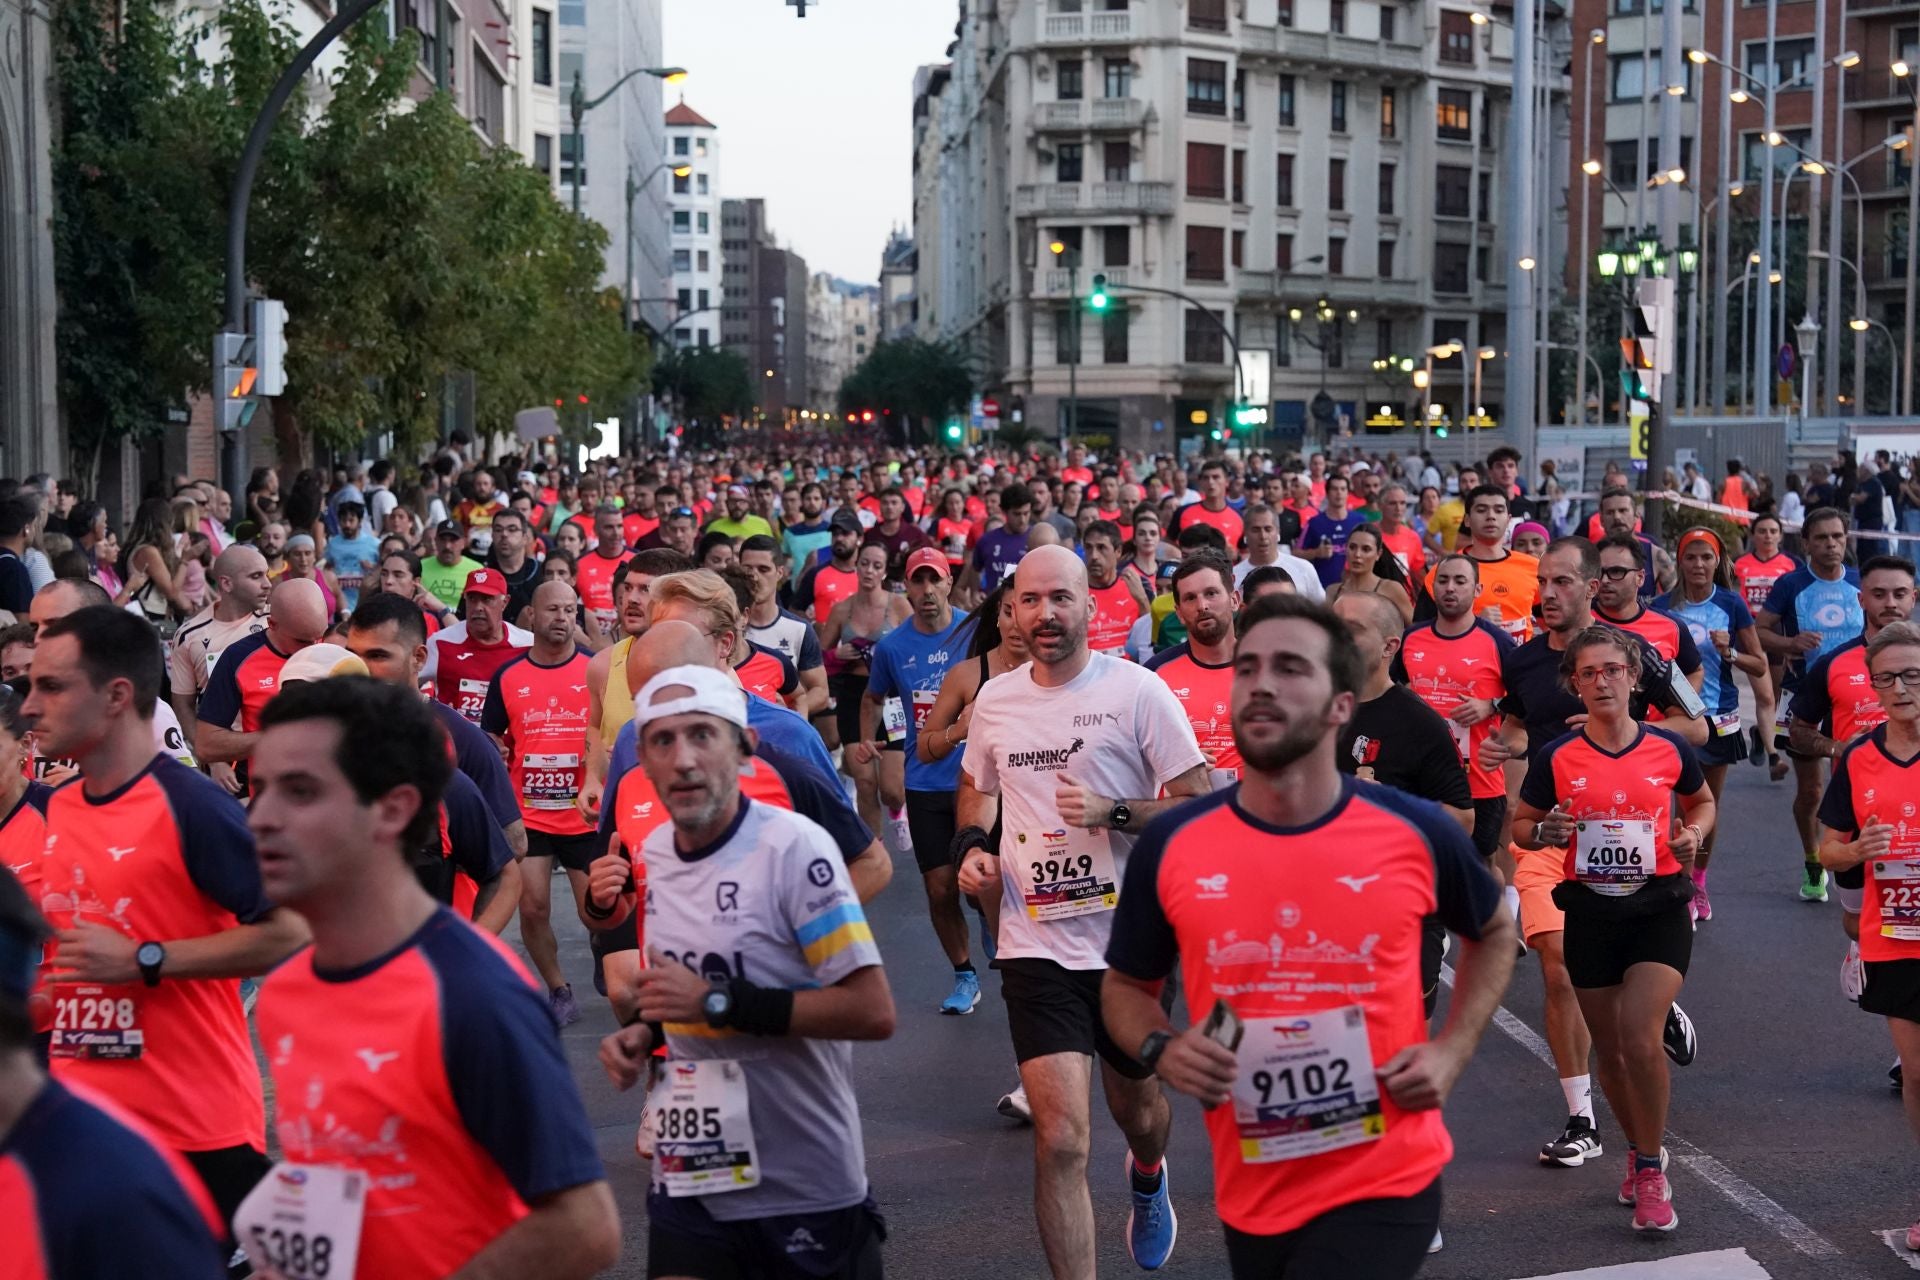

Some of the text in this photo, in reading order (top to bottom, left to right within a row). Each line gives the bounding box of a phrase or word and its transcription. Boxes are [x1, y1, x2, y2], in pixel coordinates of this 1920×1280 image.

[928, 649, 949, 665] edp
[1073, 713, 1102, 728] RUN
[1008, 749, 1069, 768] RUNNING
[1033, 763, 1068, 772] Bordeaux
[525, 772, 575, 788] 22339
[1049, 849, 1066, 857] BRET
[1587, 846, 1642, 866] 4006
[1031, 854, 1093, 884] 3949
[55, 998, 135, 1030] 21298
[1252, 1058, 1354, 1105] 9102
[656, 1107, 722, 1139] 3885
